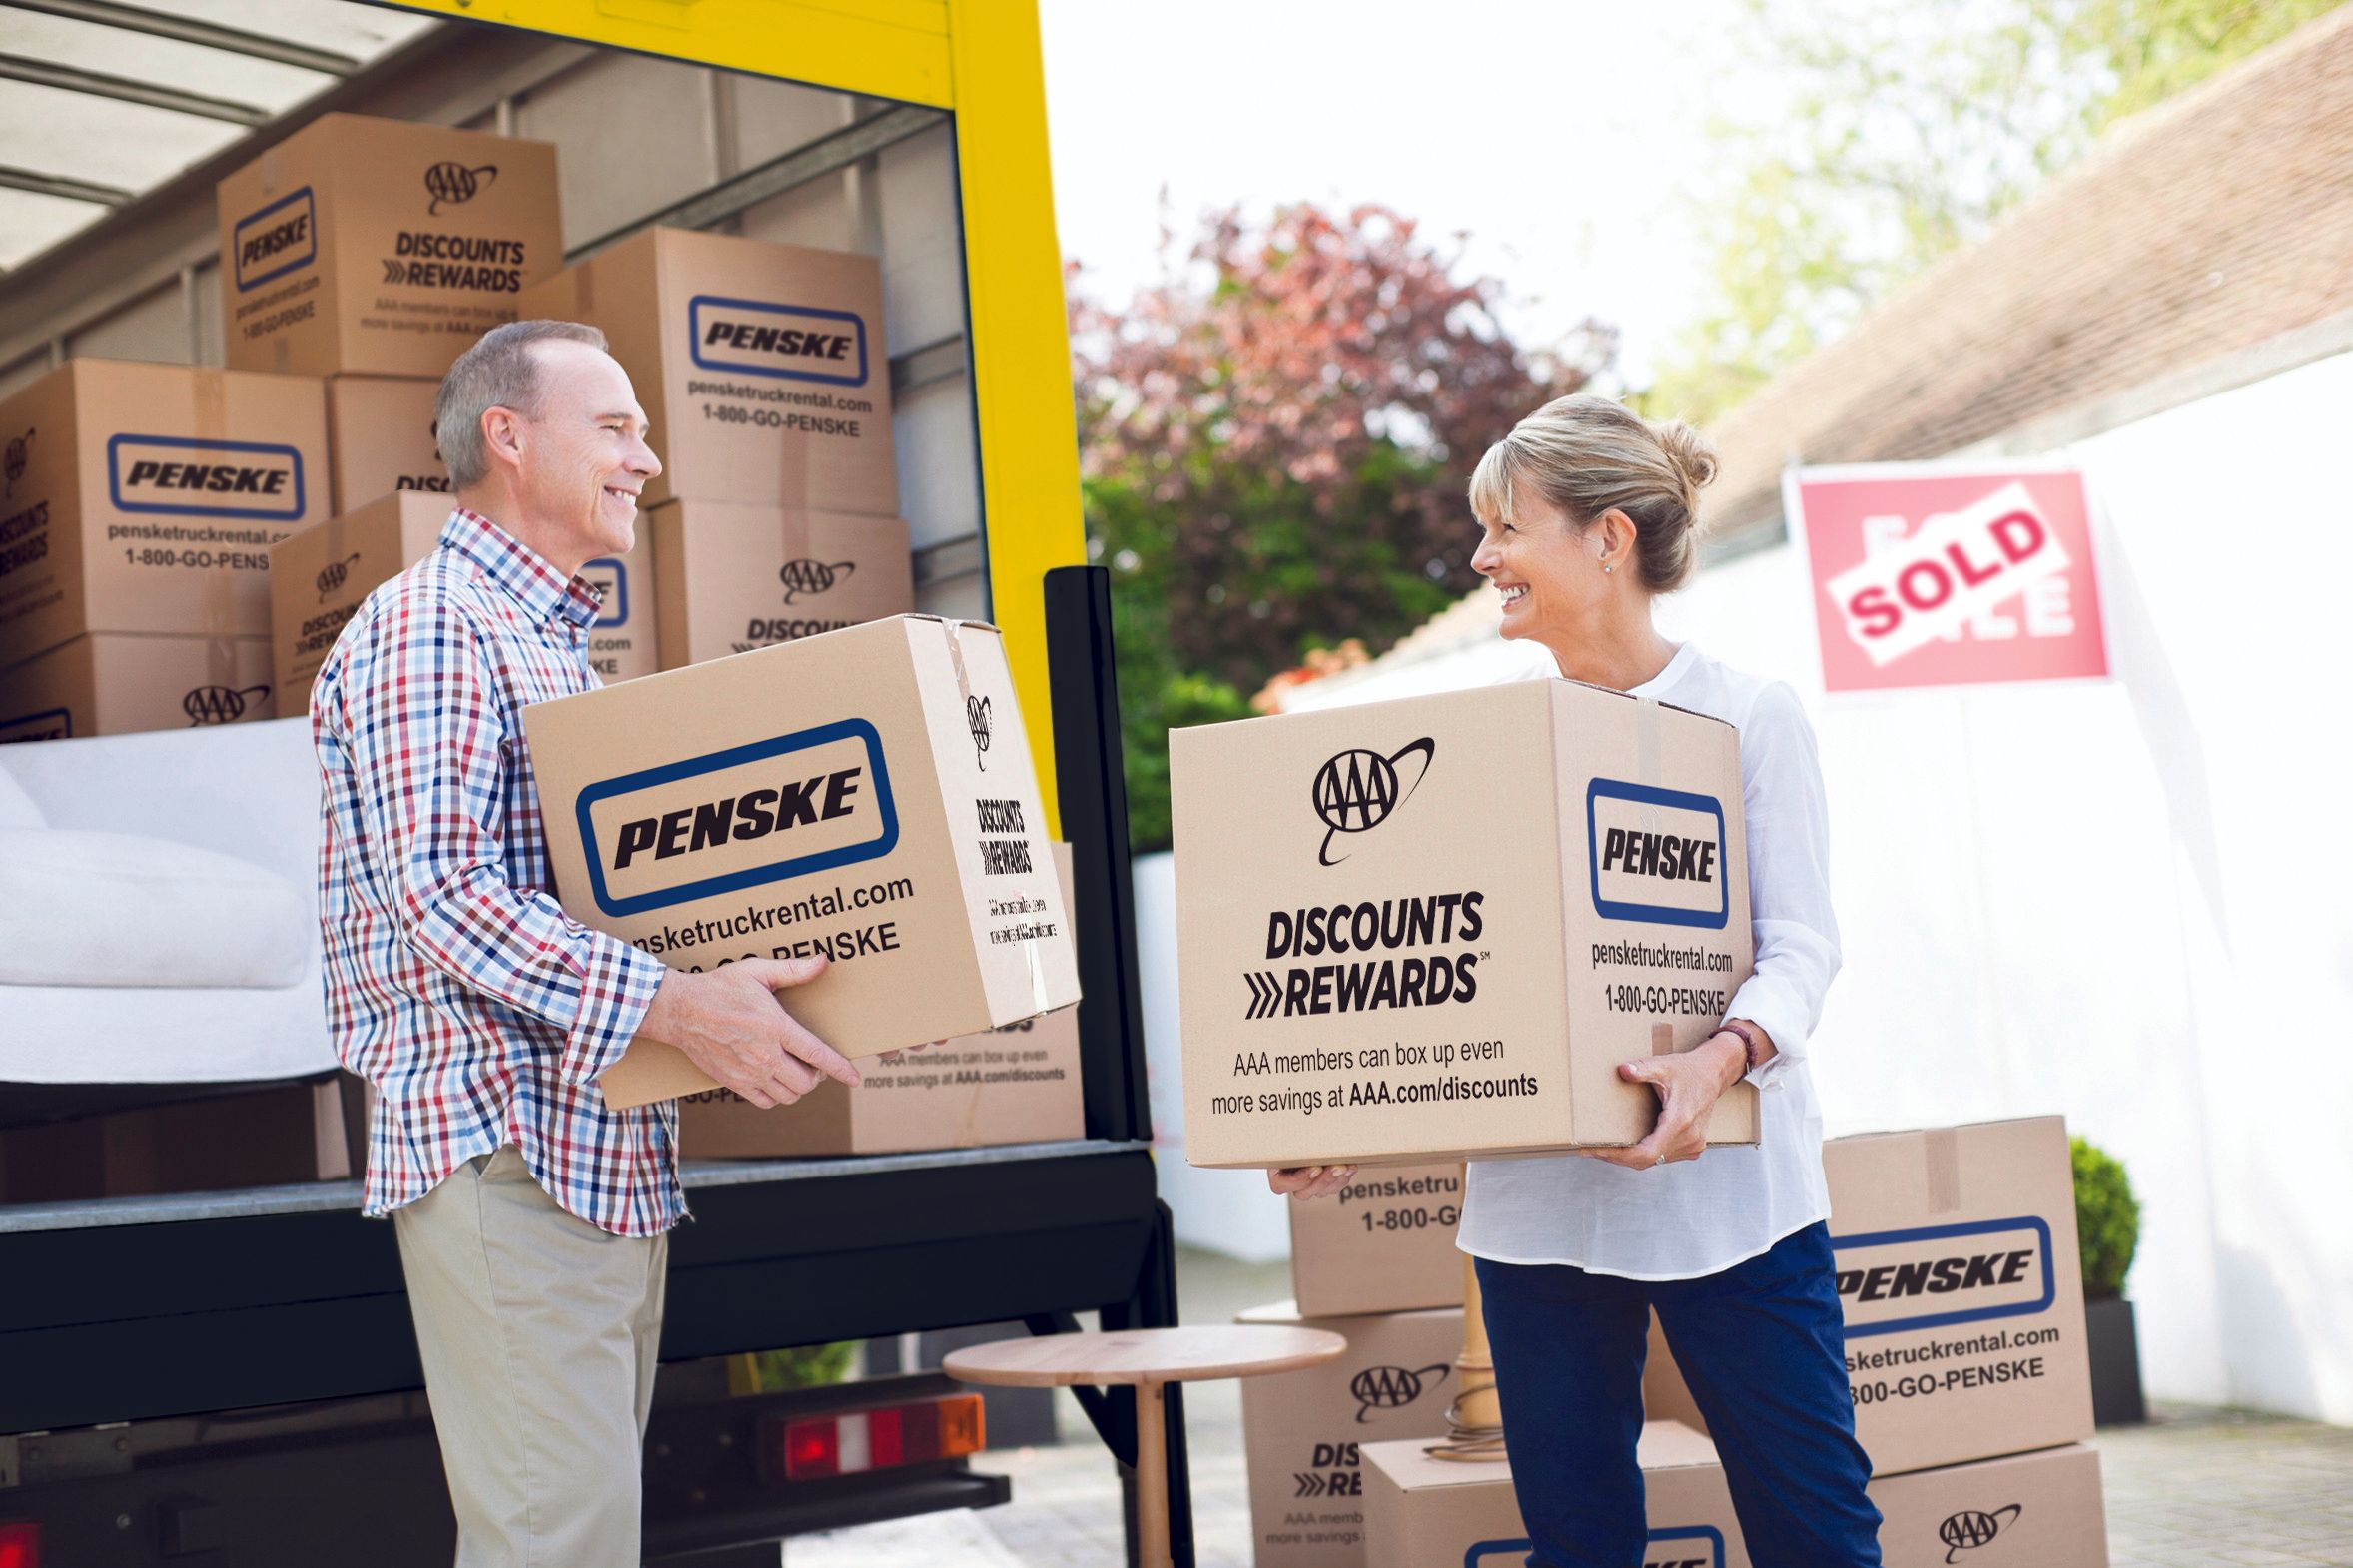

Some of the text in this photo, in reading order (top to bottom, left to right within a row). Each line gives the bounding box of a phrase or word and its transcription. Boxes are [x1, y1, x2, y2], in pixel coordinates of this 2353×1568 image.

[425, 161, 477, 204] AAA
[242, 213, 309, 267] PENSKE
[396, 231, 524, 265] DISCOUNTS
[407, 262, 520, 293] REWARDS
[705, 322, 852, 360] PENSKE
[688, 381, 872, 413] pensketruckrental.com
[703, 403, 860, 437] 1-800-GO-PENSKE
[126, 460, 289, 494] PENSKE
[780, 559, 834, 594] AAA
[1849, 509, 2045, 638] SOLD
[184, 685, 245, 722] AAA
[1313, 749, 1398, 832] AAA
[614, 766, 862, 870] PENSKE
[976, 799, 1025, 833] DISCOUNTS
[991, 840, 1032, 875] REWARDS
[1603, 827, 1716, 883] PENSKE
[1265, 891, 1484, 959] DISCOUNTS
[1592, 940, 1733, 972] pensketruckrental.com
[1284, 952, 1478, 1017] REWARDS
[1606, 984, 1725, 1017] 1-800-GO-PENSKE
[908, 1051, 960, 1066] members
[962, 1052, 981, 1064] can
[985, 1050, 1003, 1062] box
[1007, 1052, 1020, 1065] up
[1234, 1041, 1504, 1077] AAA members can box up even
[864, 1075, 894, 1088] more
[897, 1073, 939, 1089] savings
[942, 1073, 953, 1085] at
[1212, 1072, 1539, 1116] more savings at AAA.com/discounts
[1836, 1249, 2034, 1302] PENSKE
[1351, 1366, 1421, 1408] AAA
[1284, 1512, 1316, 1525] AAA
[1940, 1511, 1997, 1548] AAA
[1266, 1530, 1359, 1545] more savings
